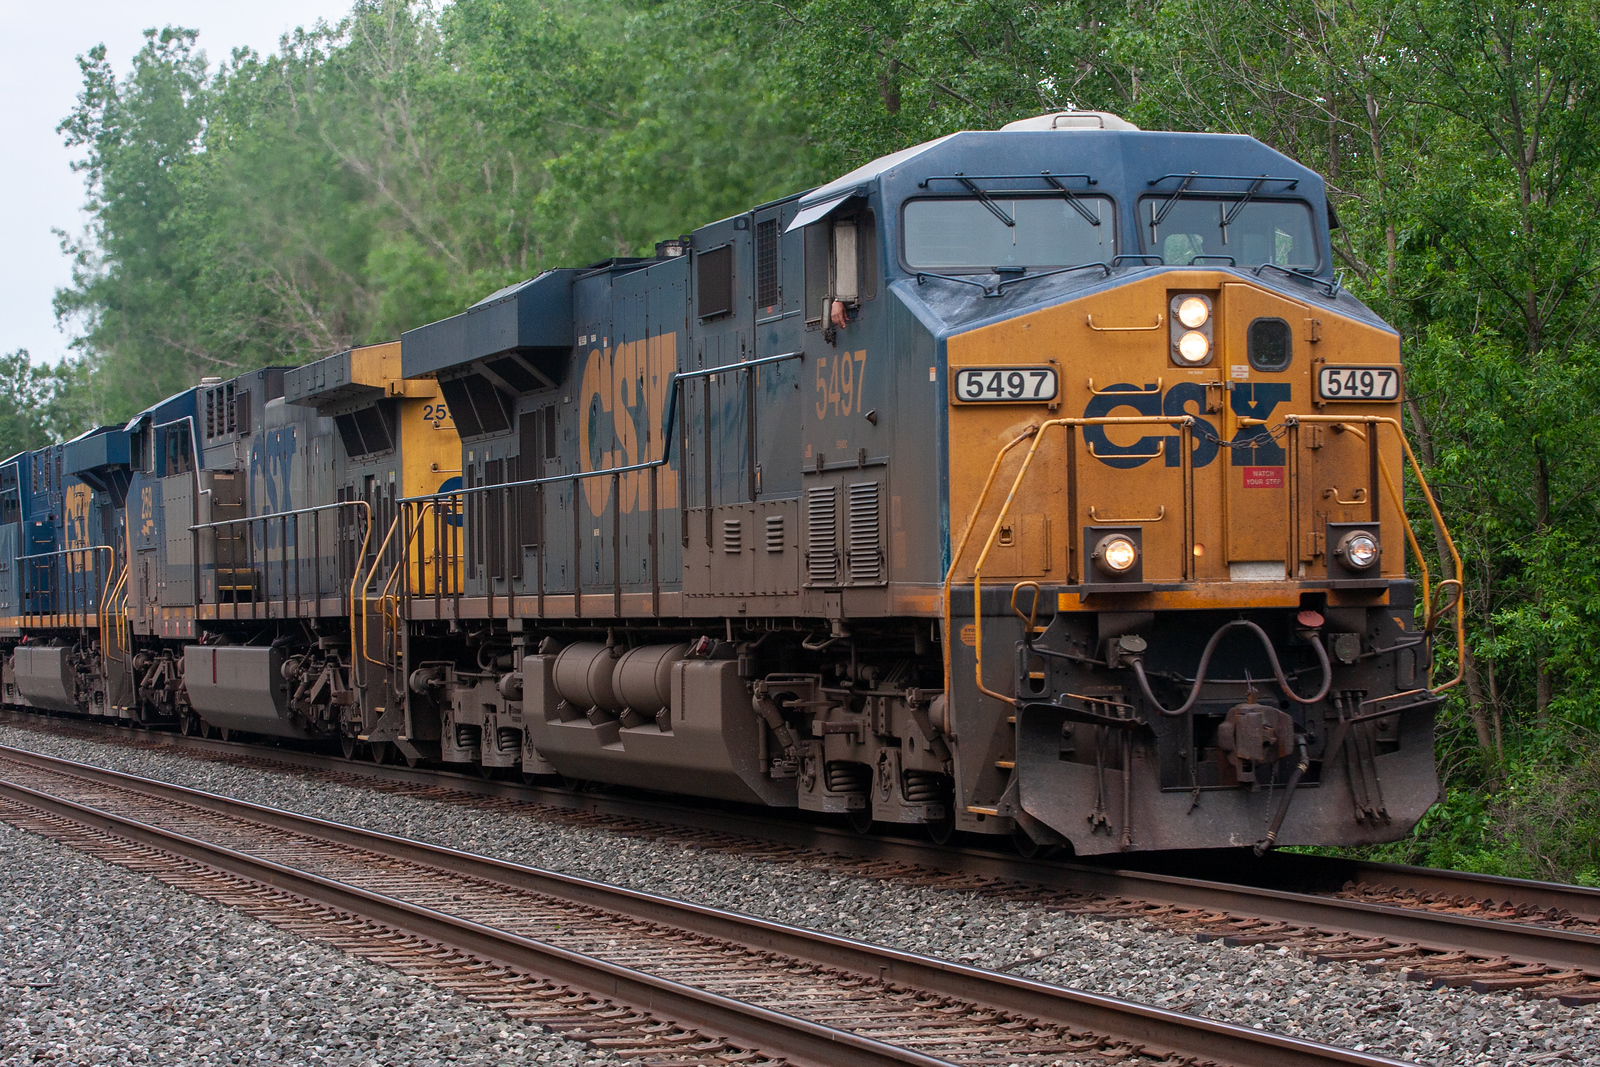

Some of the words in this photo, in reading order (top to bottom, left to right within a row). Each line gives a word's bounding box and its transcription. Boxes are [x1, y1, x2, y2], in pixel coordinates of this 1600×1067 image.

[423, 404, 453, 421] 25
[816, 349, 867, 420] 5497
[966, 371, 1048, 398] 5497
[1327, 370, 1393, 397] 5497
[579, 331, 679, 518] CSX
[1082, 381, 1292, 470] CSX
[250, 426, 297, 551] CSX
